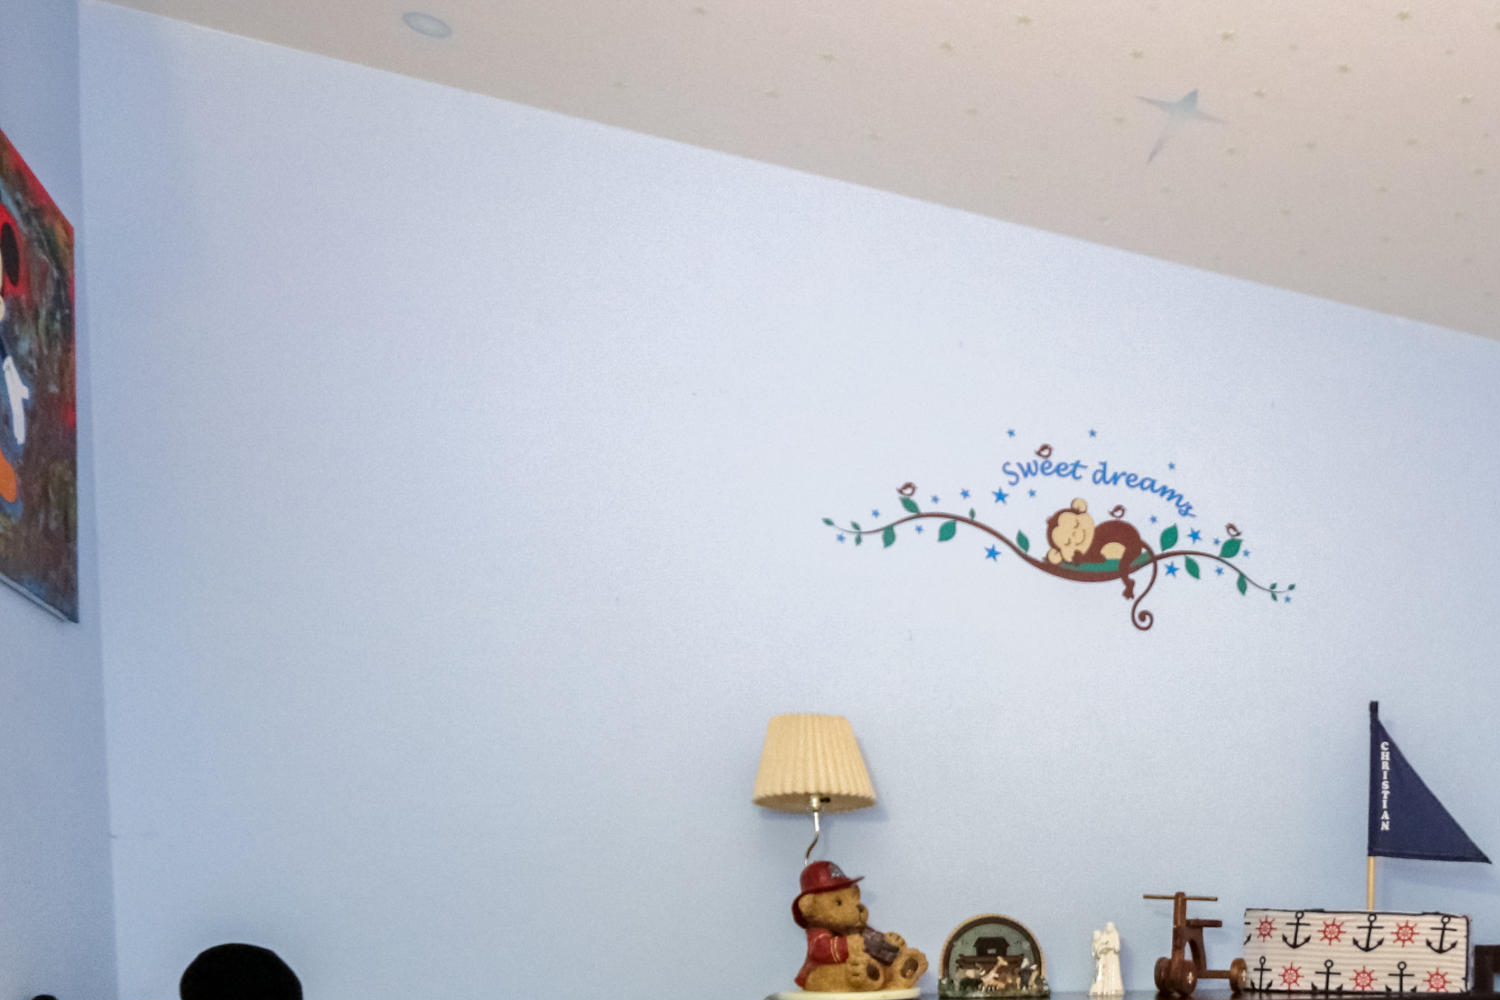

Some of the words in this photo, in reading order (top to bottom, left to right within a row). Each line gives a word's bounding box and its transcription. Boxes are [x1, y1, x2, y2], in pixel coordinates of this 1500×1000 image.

[1001, 459, 1088, 486] Sweet
[1092, 461, 1197, 518] dreams
[1380, 741, 1390, 831] CHRISTIAN
